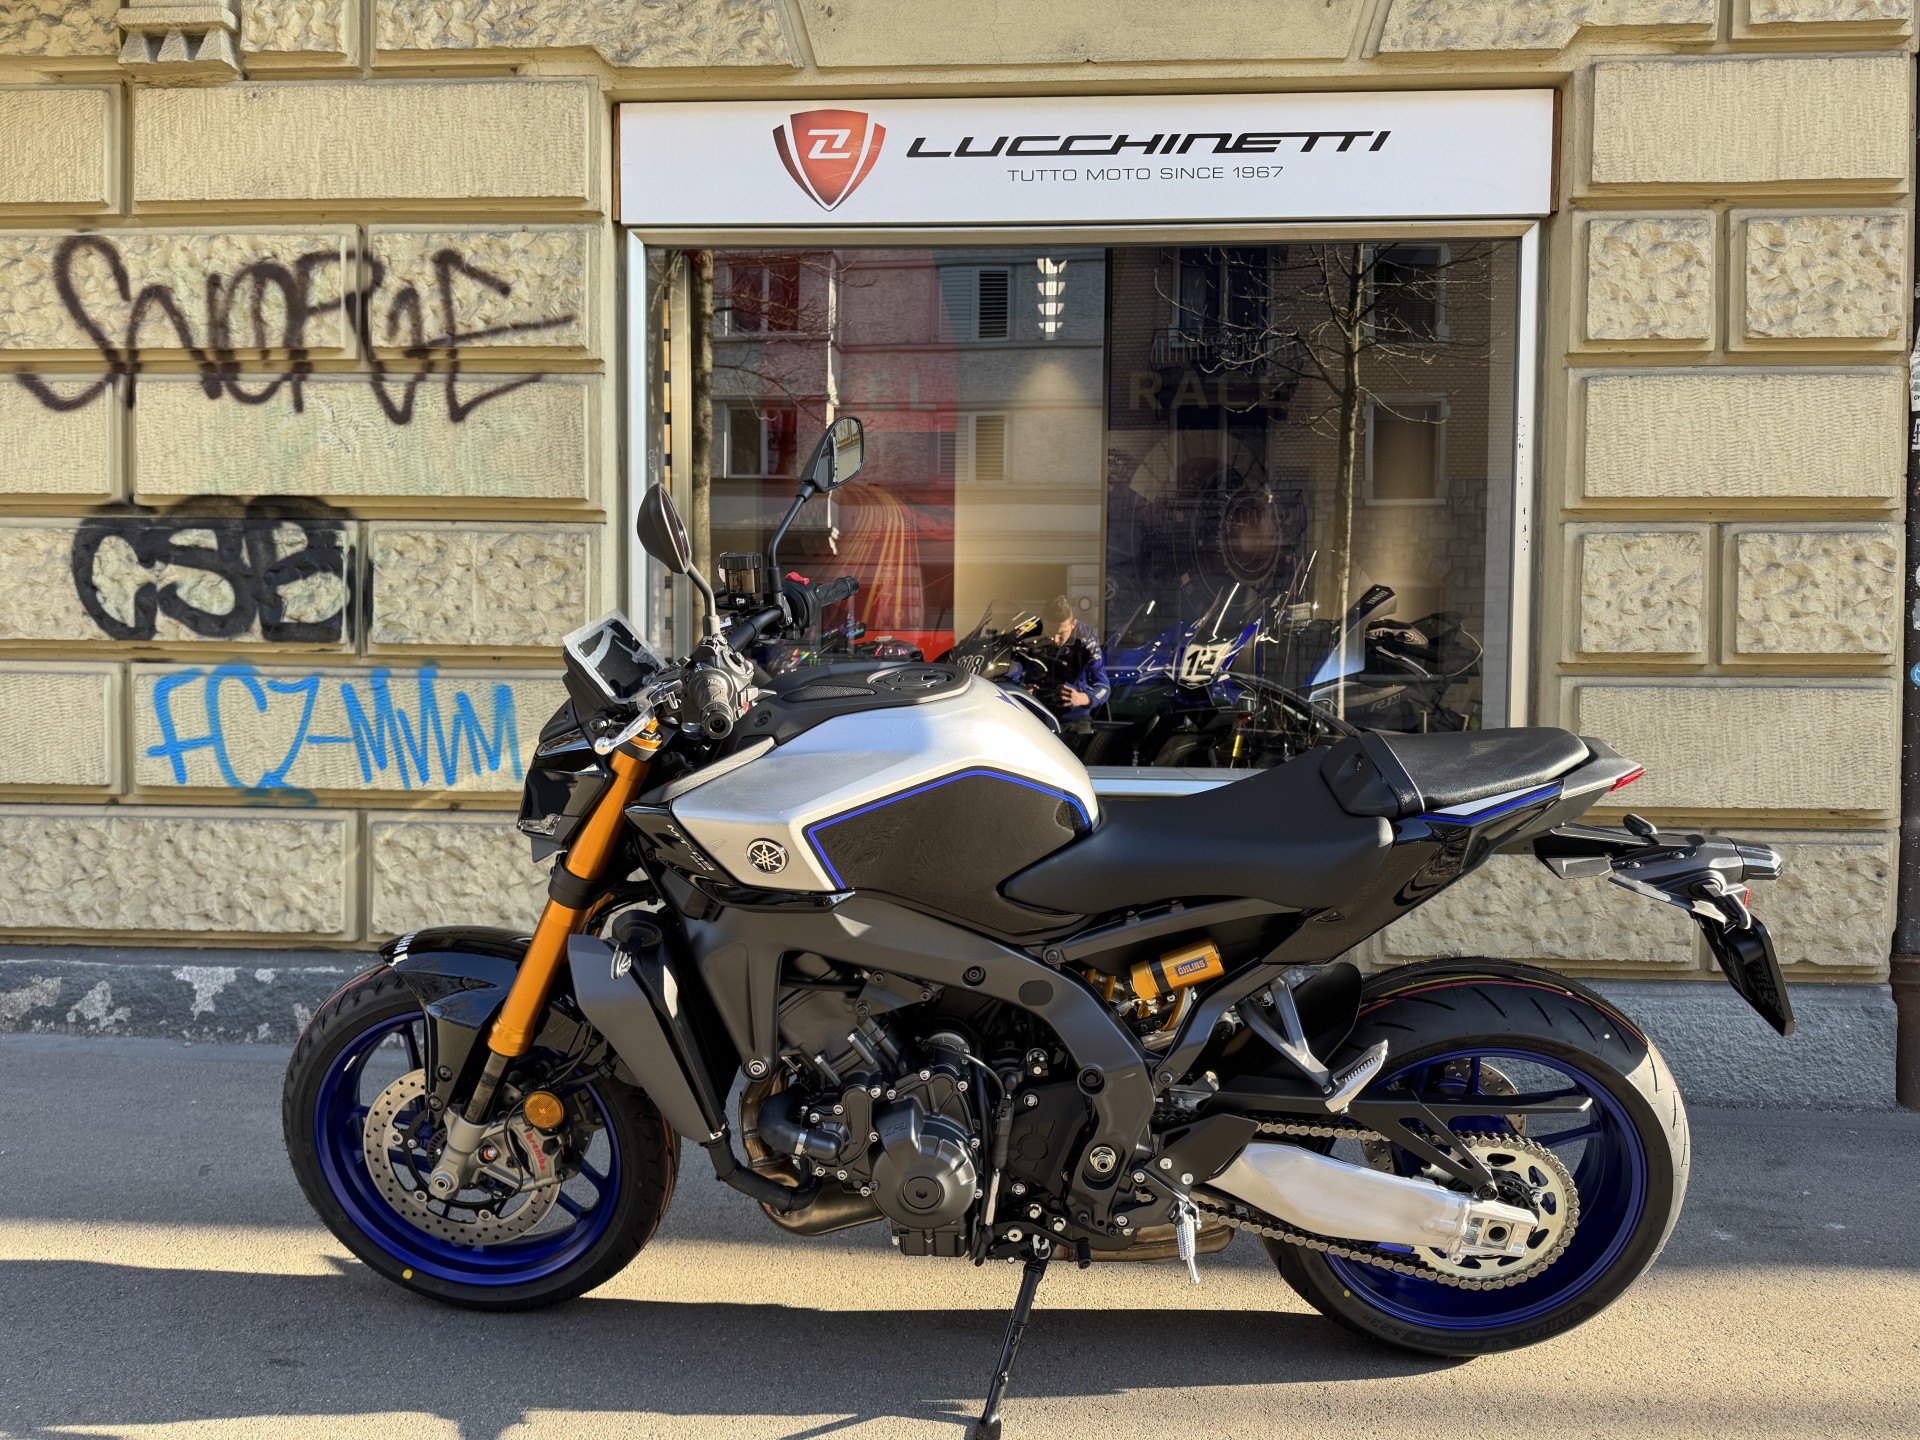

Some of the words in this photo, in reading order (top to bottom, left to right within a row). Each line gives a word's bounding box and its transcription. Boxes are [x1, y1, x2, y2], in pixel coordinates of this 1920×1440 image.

[906, 131, 1391, 158] LUCCHINETTI
[1007, 169, 1077, 182] TUTTO
[1086, 168, 1151, 181] MOTO
[1160, 167, 1224, 180] SINCE
[1233, 166, 1284, 179] 1967
[526, 1132, 547, 1172] brembo
